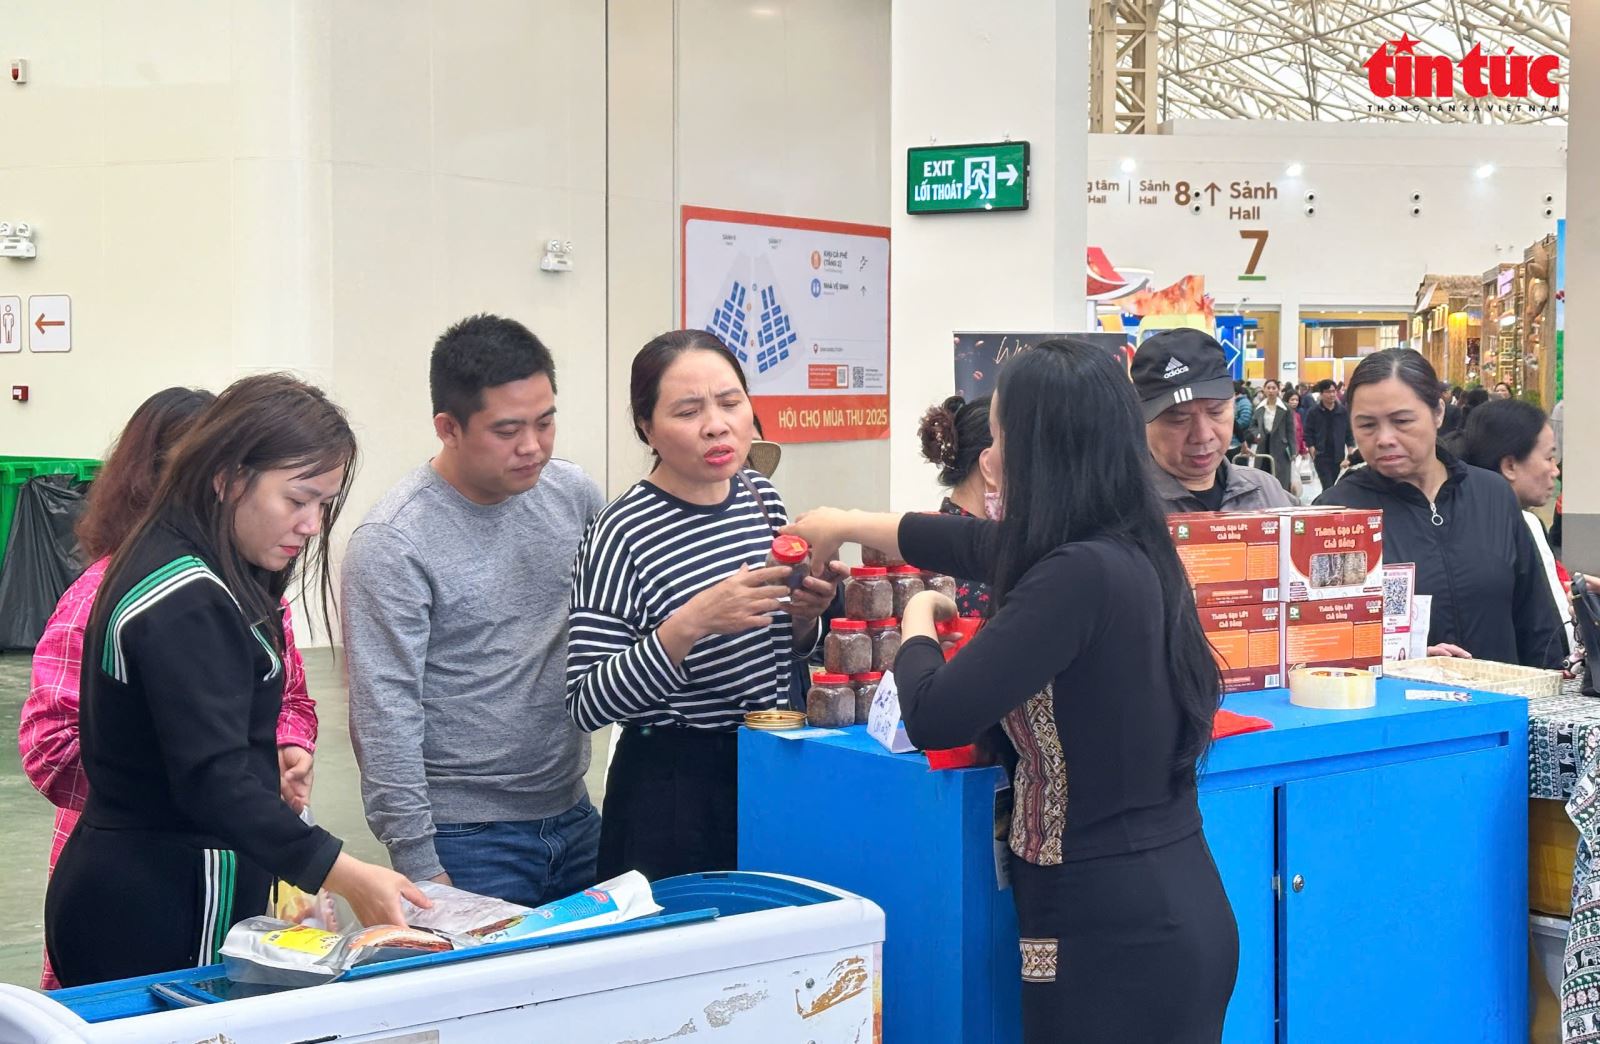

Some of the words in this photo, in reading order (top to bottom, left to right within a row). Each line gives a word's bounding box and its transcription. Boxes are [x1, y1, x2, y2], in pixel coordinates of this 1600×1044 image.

[923, 160, 955, 177] EXIT
[914, 179, 931, 201] LỐI
[932, 179, 963, 200] THOÁT
[1095, 180, 1120, 191] tâm
[1139, 180, 1170, 192] Sảnh
[1174, 181, 1191, 206] 8
[1230, 180, 1278, 200] Sảnh
[1088, 195, 1107, 204] Hall
[1139, 195, 1158, 205] Hall
[1229, 206, 1261, 220] Hall
[1239, 230, 1269, 275] 7
[1163, 365, 1190, 379] adidas
[778, 407, 797, 430] HỘI
[799, 407, 820, 429] CHỢ
[823, 407, 844, 428] MÙA
[846, 409, 864, 426] THU
[865, 408, 887, 425] 2025
